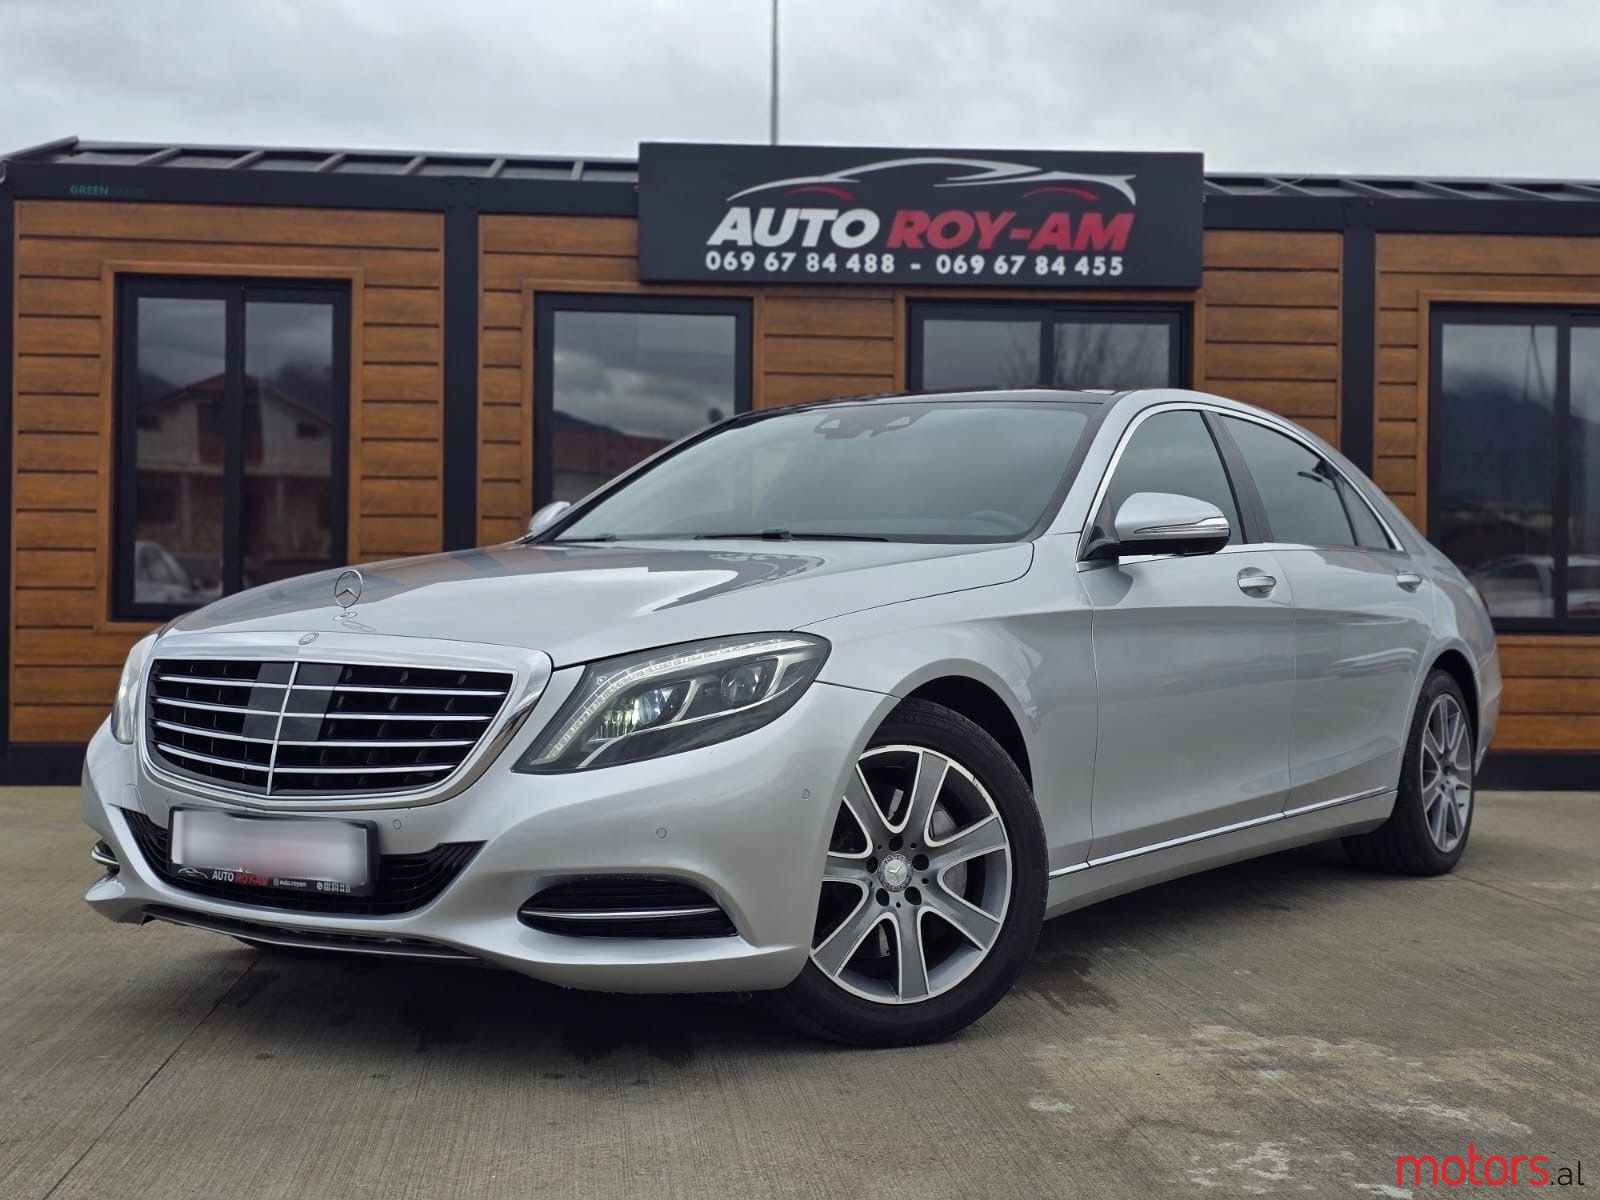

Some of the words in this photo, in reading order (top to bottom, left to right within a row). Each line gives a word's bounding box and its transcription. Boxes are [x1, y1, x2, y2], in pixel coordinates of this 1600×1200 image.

[706, 207, 881, 248] AUTO
[886, 209, 1135, 251] ROY-AM
[705, 250, 755, 271] 069
[764, 251, 797, 272] 67
[806, 252, 837, 273] 84
[846, 253, 895, 273] 488
[911, 263, 921, 271] -
[936, 254, 985, 275] 069
[994, 255, 1026, 275] 67
[1035, 255, 1066, 276] 84
[1074, 255, 1123, 276] 455
[212, 870, 235, 882] AUTO
